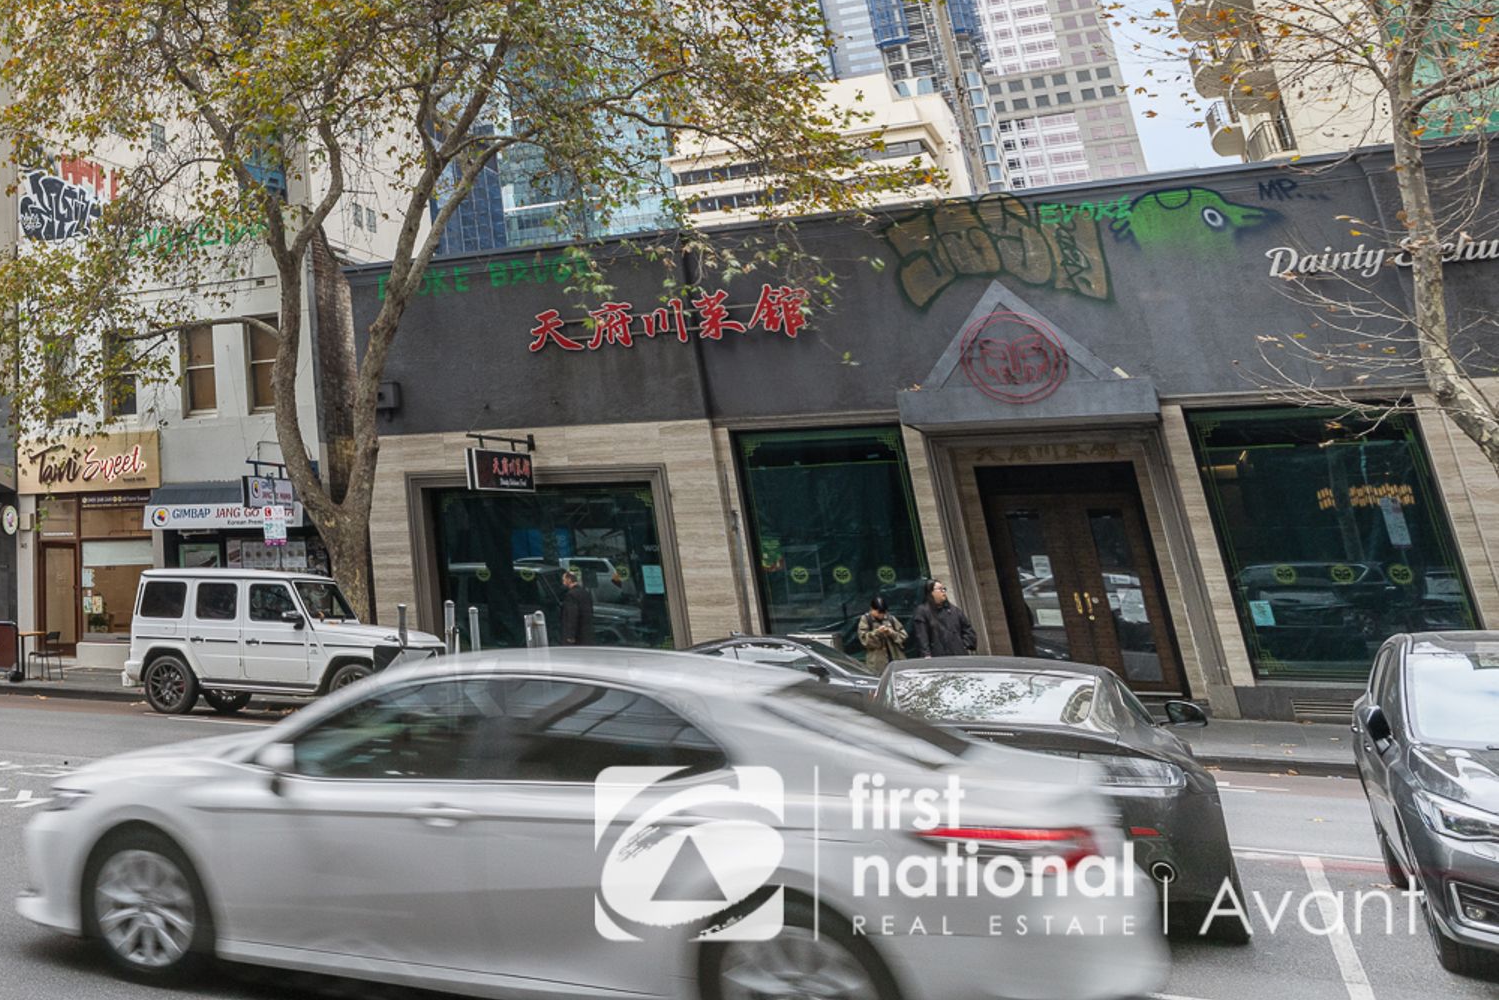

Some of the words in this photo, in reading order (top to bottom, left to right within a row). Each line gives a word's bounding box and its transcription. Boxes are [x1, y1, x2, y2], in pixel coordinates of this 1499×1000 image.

[1265, 244, 1385, 277] Dainty
[172, 507, 211, 520] GIMBAP
[215, 507, 241, 518] JANG
